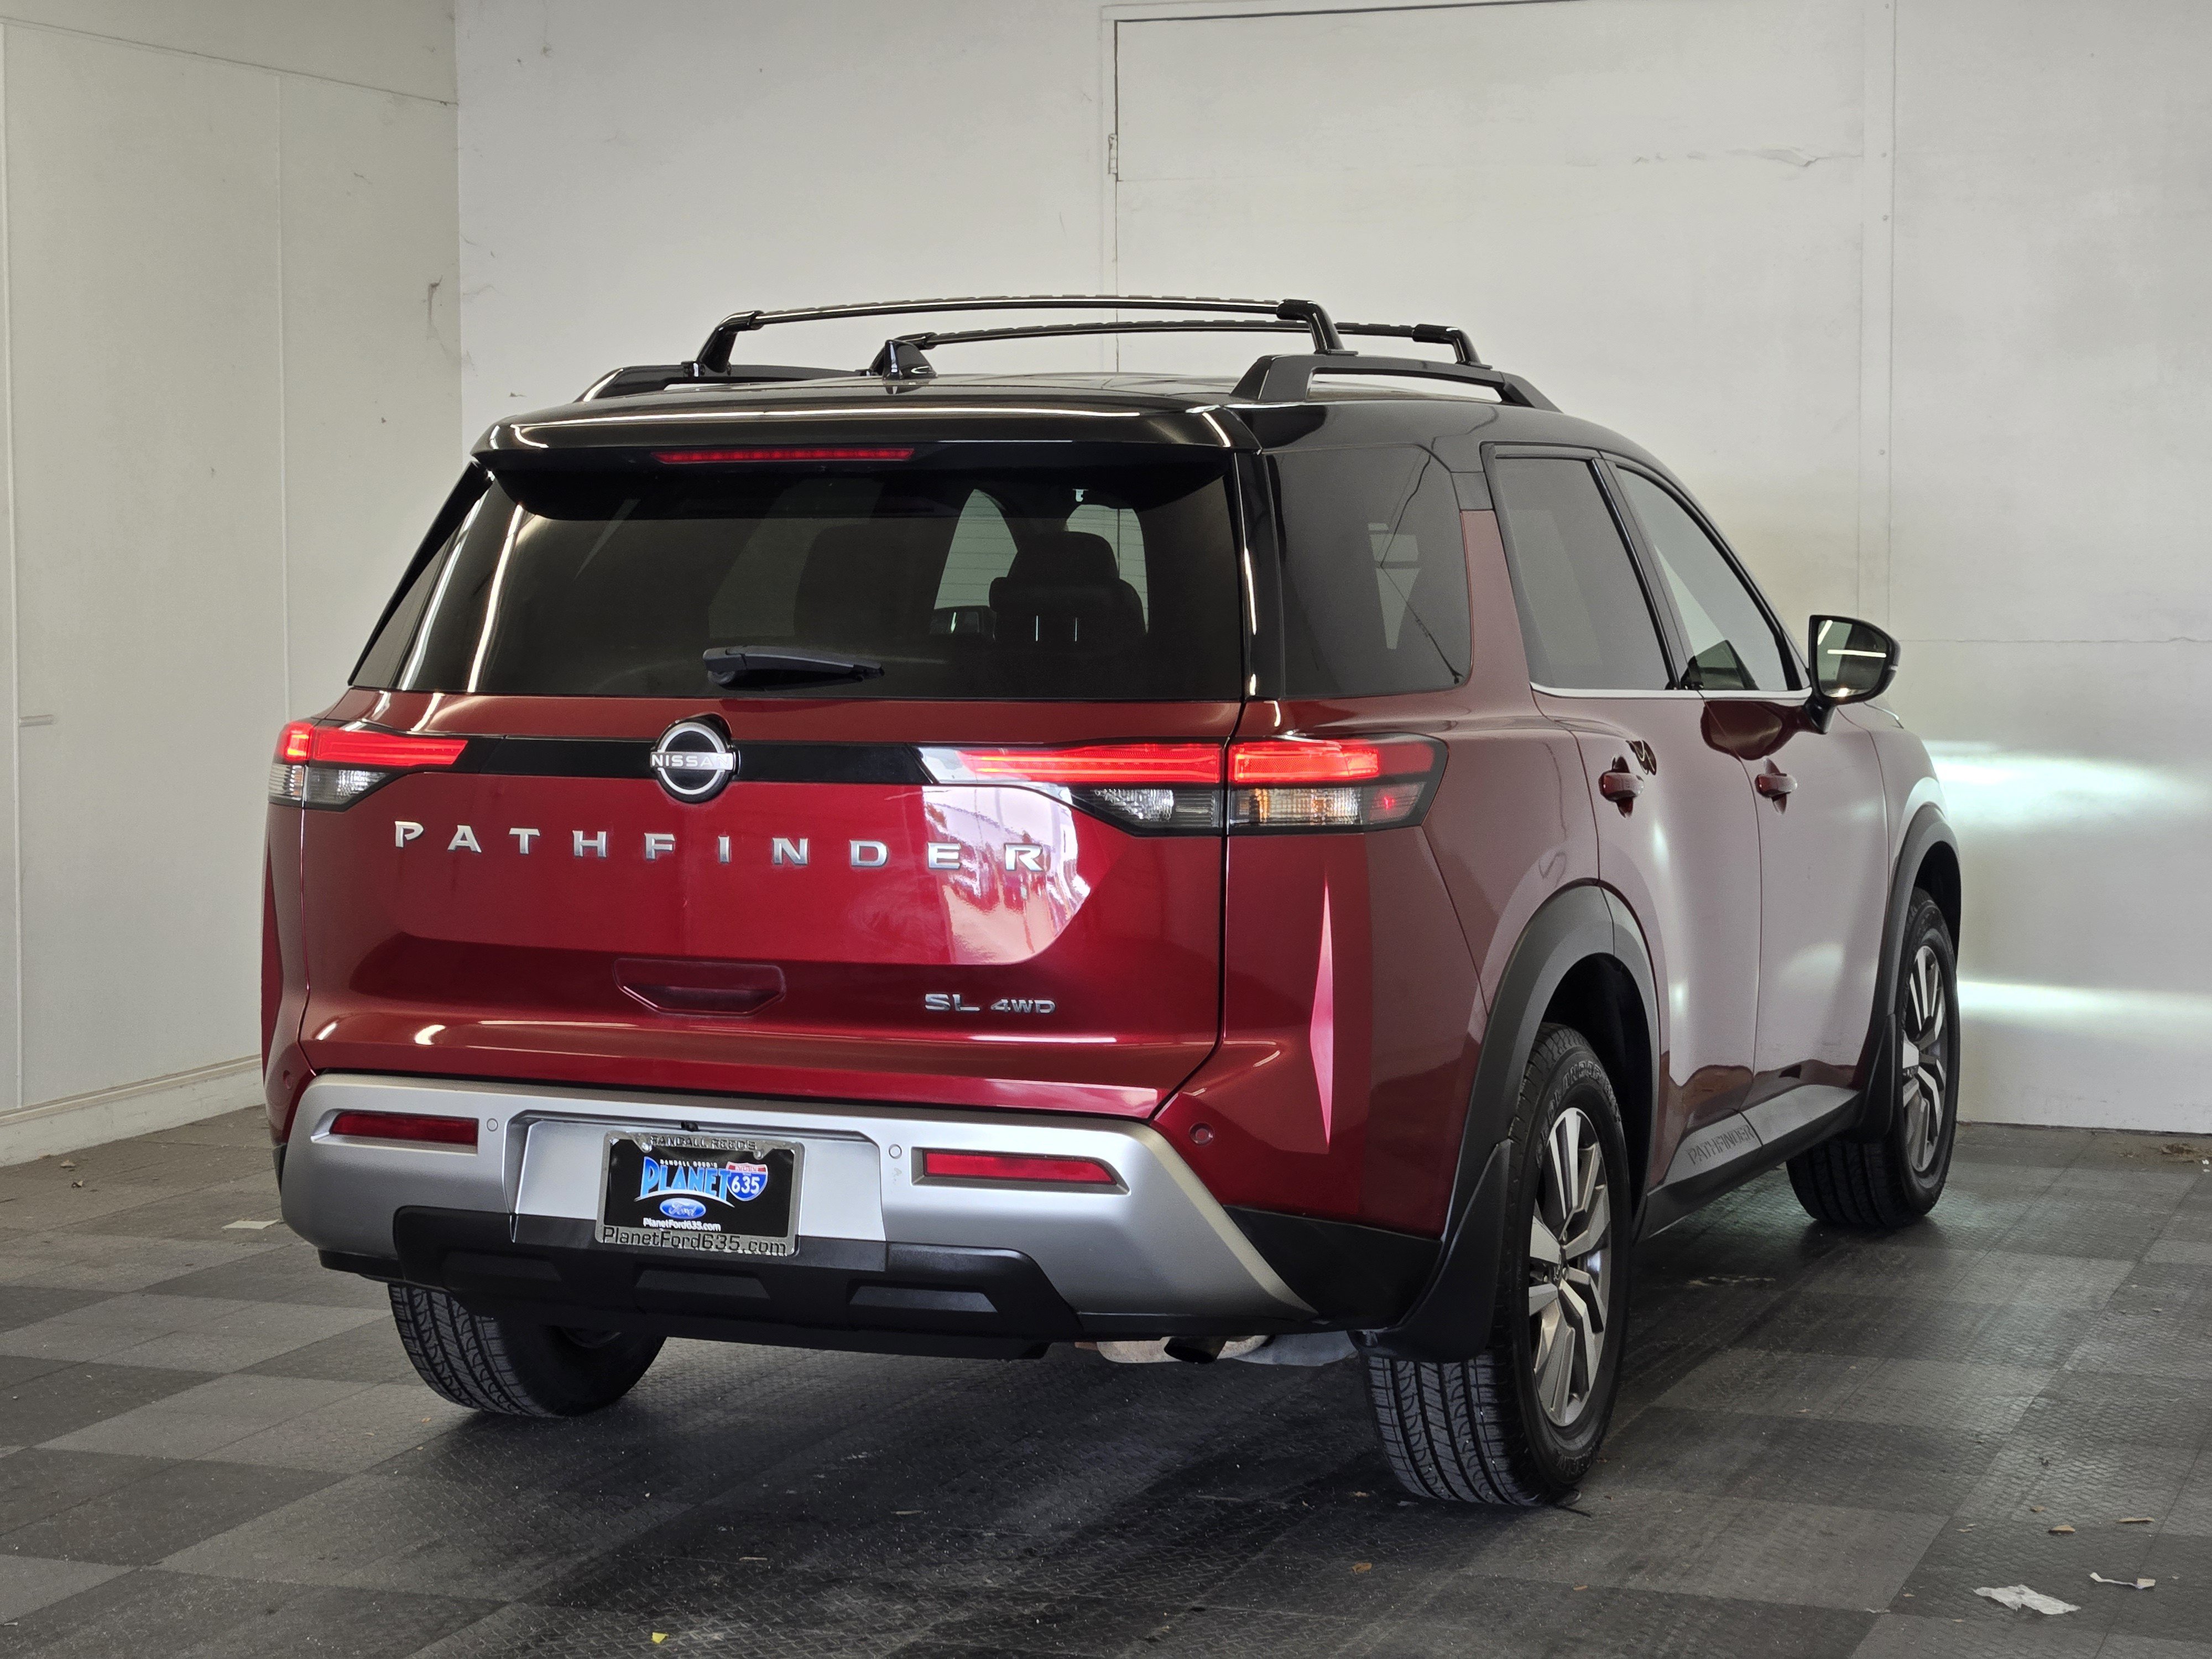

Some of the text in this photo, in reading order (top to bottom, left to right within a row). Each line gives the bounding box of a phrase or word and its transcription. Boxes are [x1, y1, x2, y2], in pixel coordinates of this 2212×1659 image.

[651, 754, 731, 768] NISSAN
[394, 820, 1045, 872] PATHFINDER
[925, 994, 1056, 1013] SL 4WD
[650, 1135, 707, 1149] RANDALL
[1687, 1124, 1755, 1165] PATHFINDER
[640, 1156, 732, 1202] PLANET
[731, 1176, 760, 1196] 635
[668, 1201, 697, 1217] Ford
[643, 1217, 722, 1232] PlanetFord635.com
[603, 1226, 787, 1256] PlanetFord635.com
